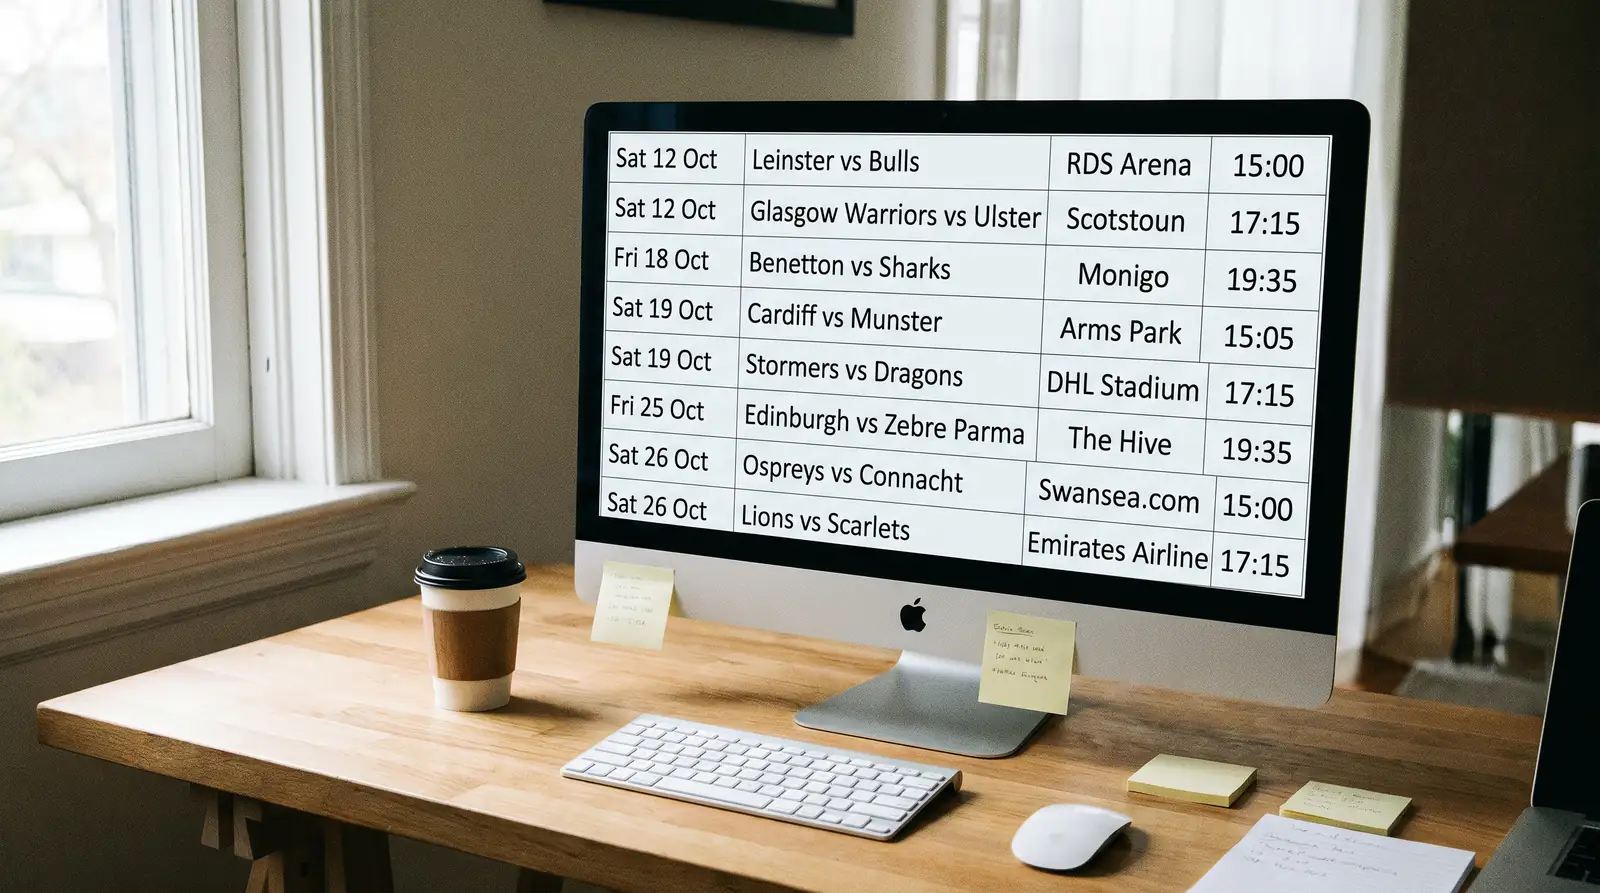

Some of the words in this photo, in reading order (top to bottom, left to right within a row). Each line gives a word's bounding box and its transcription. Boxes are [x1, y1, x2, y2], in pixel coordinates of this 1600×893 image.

[616, 147, 647, 169] Sat
[653, 147, 677, 169] 12
[683, 147, 718, 170] Oct
[753, 148, 835, 171] Leinster
[840, 154, 862, 172] vs
[869, 148, 920, 173] Bulls
[1067, 151, 1113, 176] RDS
[1119, 152, 1191, 177] Arena
[1233, 153, 1305, 178] 15:00
[615, 196, 646, 218] Sat
[652, 197, 675, 219] 12
[681, 198, 717, 221] Oct
[750, 199, 839, 228] Glasgow
[844, 202, 937, 226] Warriors
[943, 209, 967, 227] vs
[974, 203, 1043, 229] Ulster
[1066, 206, 1185, 233] Scotstoun
[1230, 210, 1300, 236] 17:15
[614, 246, 638, 268] Fri
[645, 247, 669, 269] 18
[674, 248, 710, 271] Oct
[749, 251, 844, 276] Benetton
[850, 260, 873, 277] vs
[879, 254, 951, 280] Sharks
[1078, 262, 1169, 293] Monigo
[1227, 267, 1297, 293] 19:35
[612, 296, 643, 318] Sat
[649, 297, 673, 319] 19
[678, 299, 714, 322] Oct
[747, 302, 818, 327] Cardiff
[821, 310, 844, 328] vs
[851, 307, 943, 333] Munster
[1059, 316, 1122, 342] Arms
[1129, 319, 1182, 345] Park
[1224, 324, 1294, 351] 15:05
[611, 345, 642, 368] Sat
[647, 347, 671, 369] 19
[677, 349, 712, 372] Oct
[745, 353, 839, 380] Stormers
[845, 363, 867, 381] vs
[874, 360, 963, 390] Dragons
[1047, 370, 1095, 396] DHL
[1100, 373, 1199, 402] Stadium
[1225, 381, 1294, 408] 17:15
[611, 394, 634, 416] Fri
[640, 396, 664, 418] 25
[670, 398, 705, 422] Oct
[745, 403, 849, 436] Edinburgh
[856, 416, 878, 434] vs
[884, 413, 947, 439] Zebre
[954, 418, 1025, 445] Parma
[1068, 425, 1112, 452] The
[1120, 429, 1172, 456] Hive
[1223, 437, 1292, 465] 19:35
[608, 442, 639, 466] Sat
[644, 445, 669, 468] 26
[674, 448, 709, 472] Oct
[743, 454, 825, 486] Ospreys
[830, 466, 853, 484] vs
[859, 463, 964, 494] Connacht
[607, 491, 638, 515] Sat
[643, 494, 667, 517] 26
[673, 497, 708, 521] Oct
[1038, 478, 1200, 514] Swansea.com
[1223, 493, 1293, 522] 15:00
[742, 504, 794, 530] Lions
[799, 514, 821, 532] vs
[827, 512, 910, 541] Scarlets
[1028, 531, 1126, 562] Emirates
[1131, 541, 1209, 570] Airline
[1221, 549, 1290, 578] 17:15
